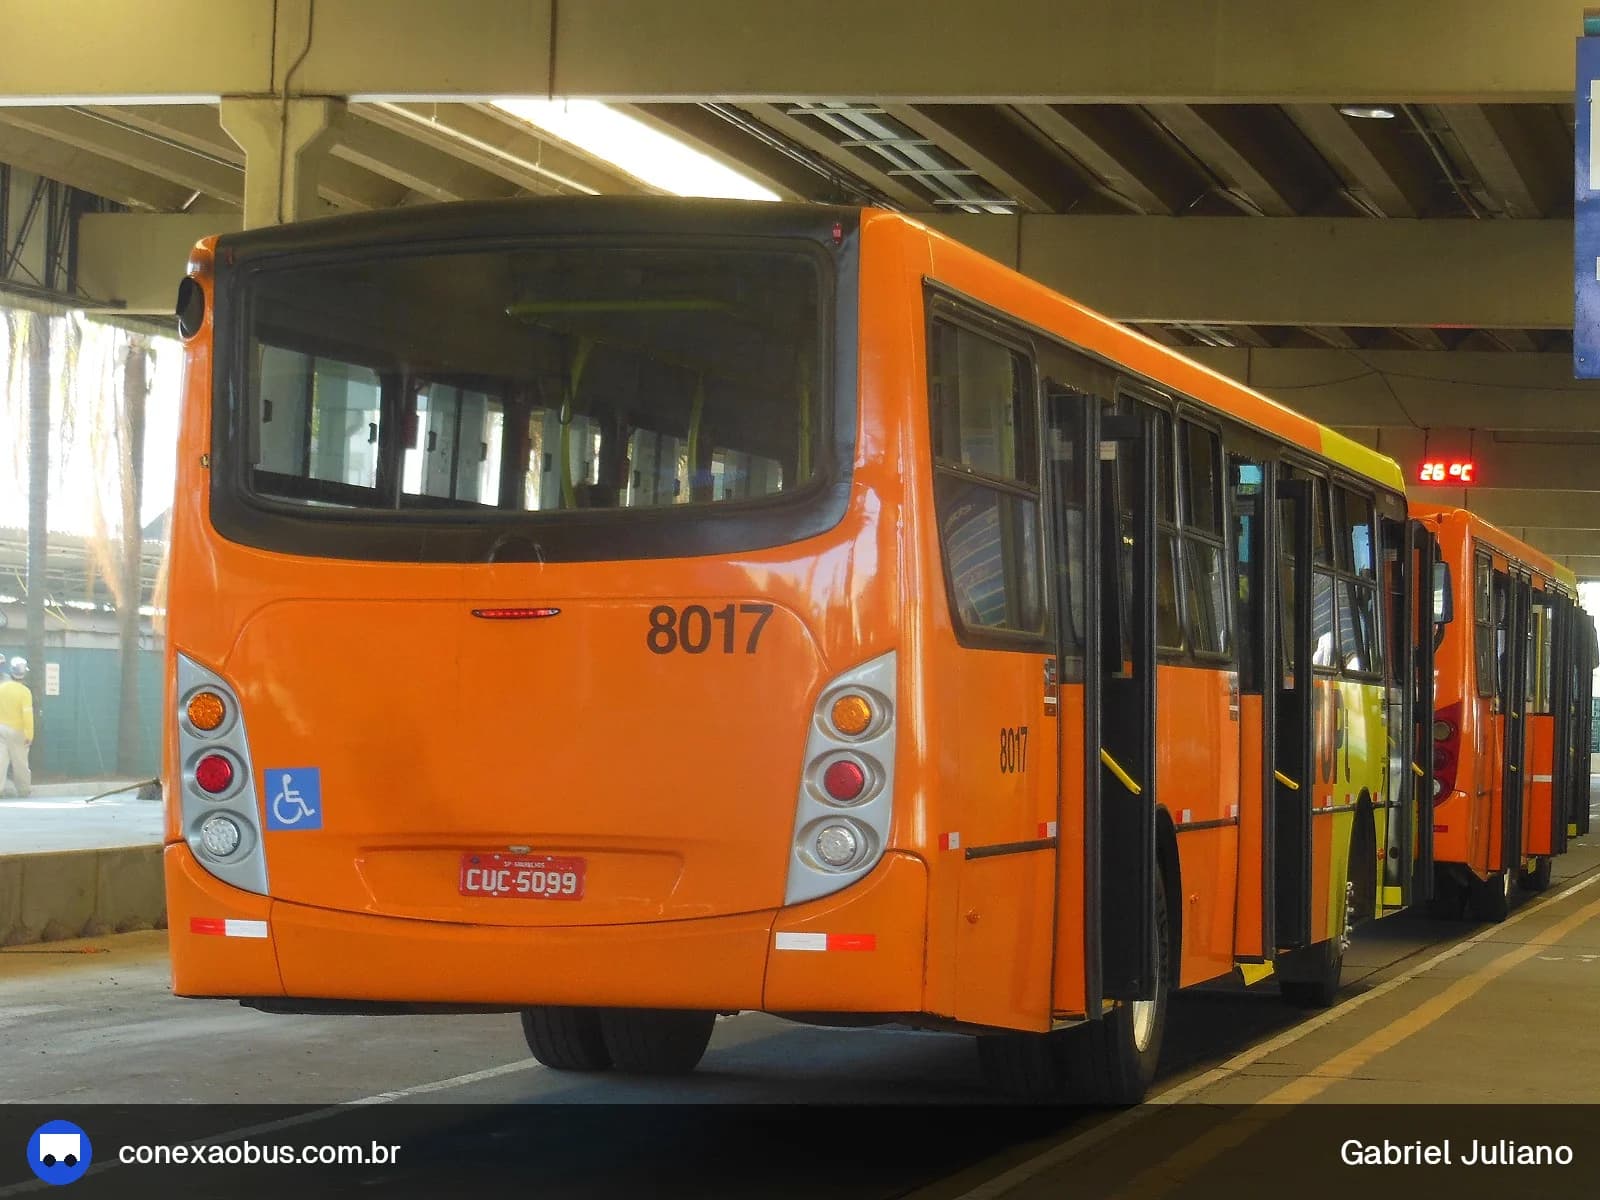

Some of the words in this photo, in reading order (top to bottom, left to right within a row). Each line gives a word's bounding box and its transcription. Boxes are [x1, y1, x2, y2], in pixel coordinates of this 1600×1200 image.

[1420, 463, 1445, 481] 26
[646, 603, 774, 654] 8017
[1000, 726, 1028, 774] 8017
